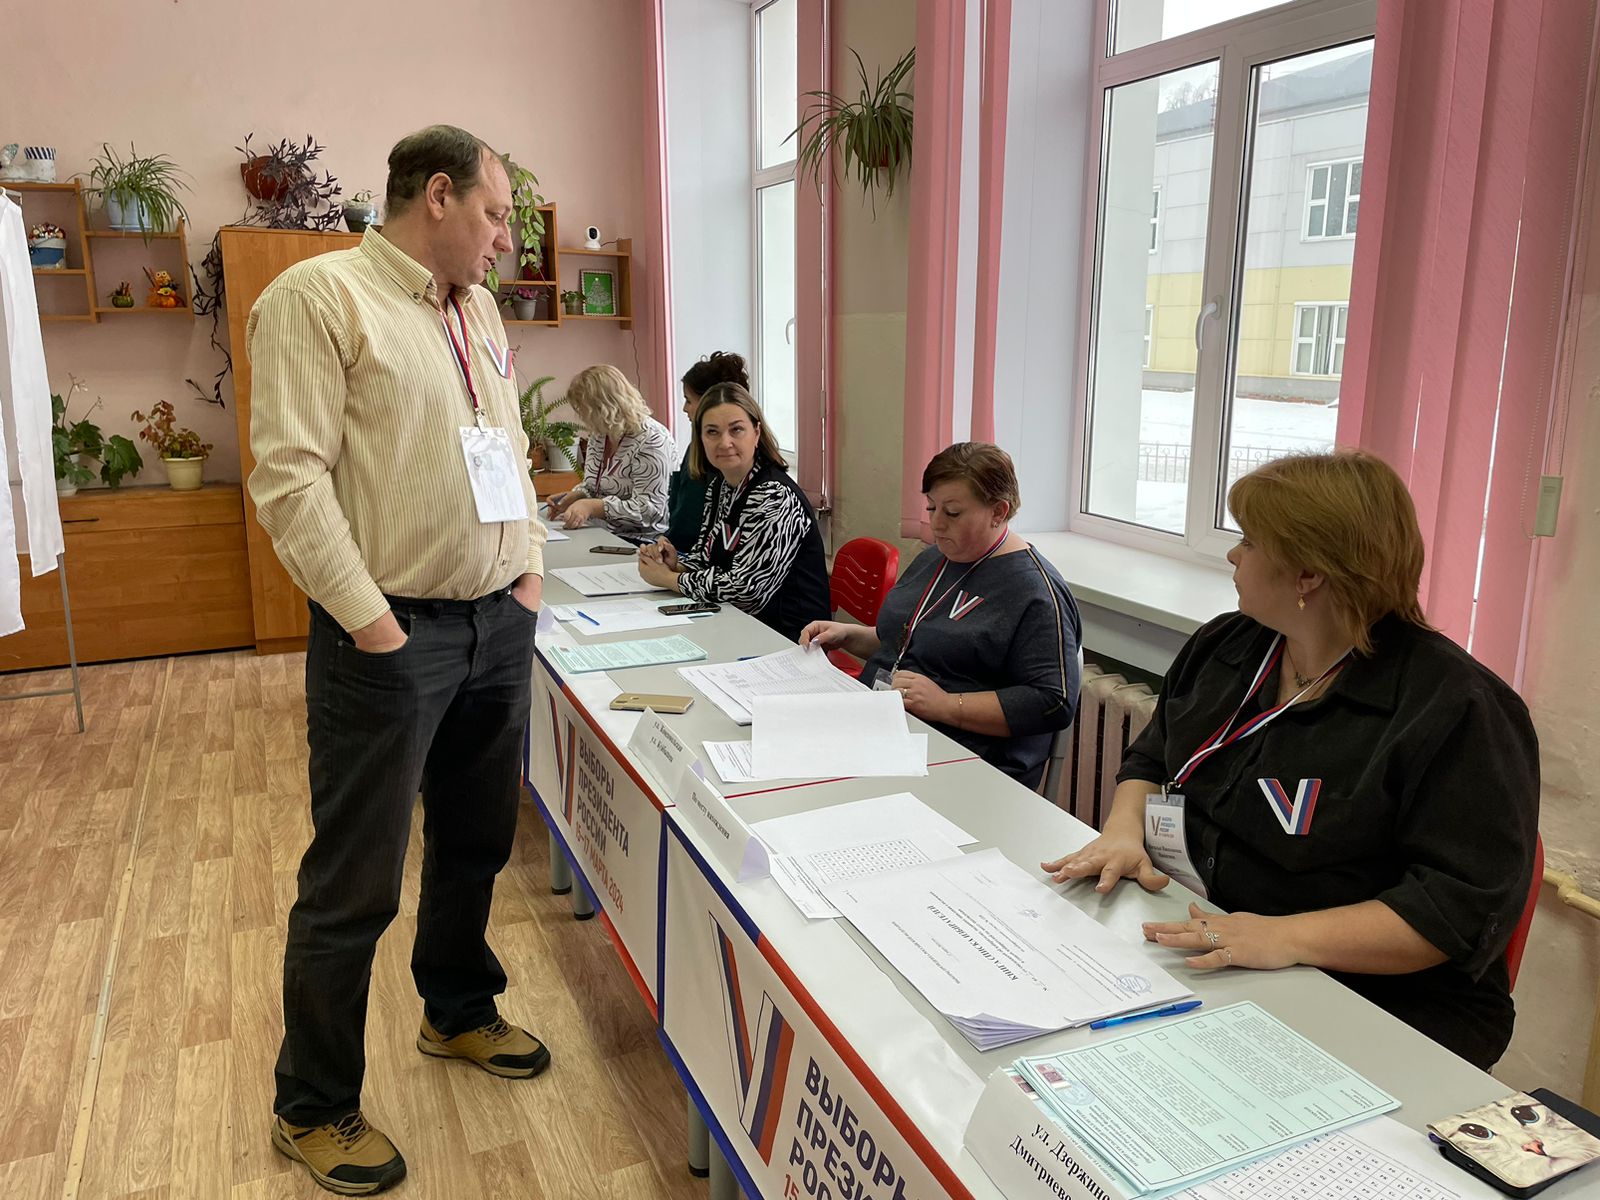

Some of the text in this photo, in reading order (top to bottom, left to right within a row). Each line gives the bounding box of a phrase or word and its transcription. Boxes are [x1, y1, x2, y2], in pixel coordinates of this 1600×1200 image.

[579, 735, 615, 801] ВЫБОРЫ
[577, 794, 607, 857] РОССИИ
[578, 765, 630, 858] ПРЕЗИДЕНТА
[589, 846, 609, 890] МАРТА
[608, 877, 624, 915] 2024
[1031, 1124, 1050, 1147] ул.
